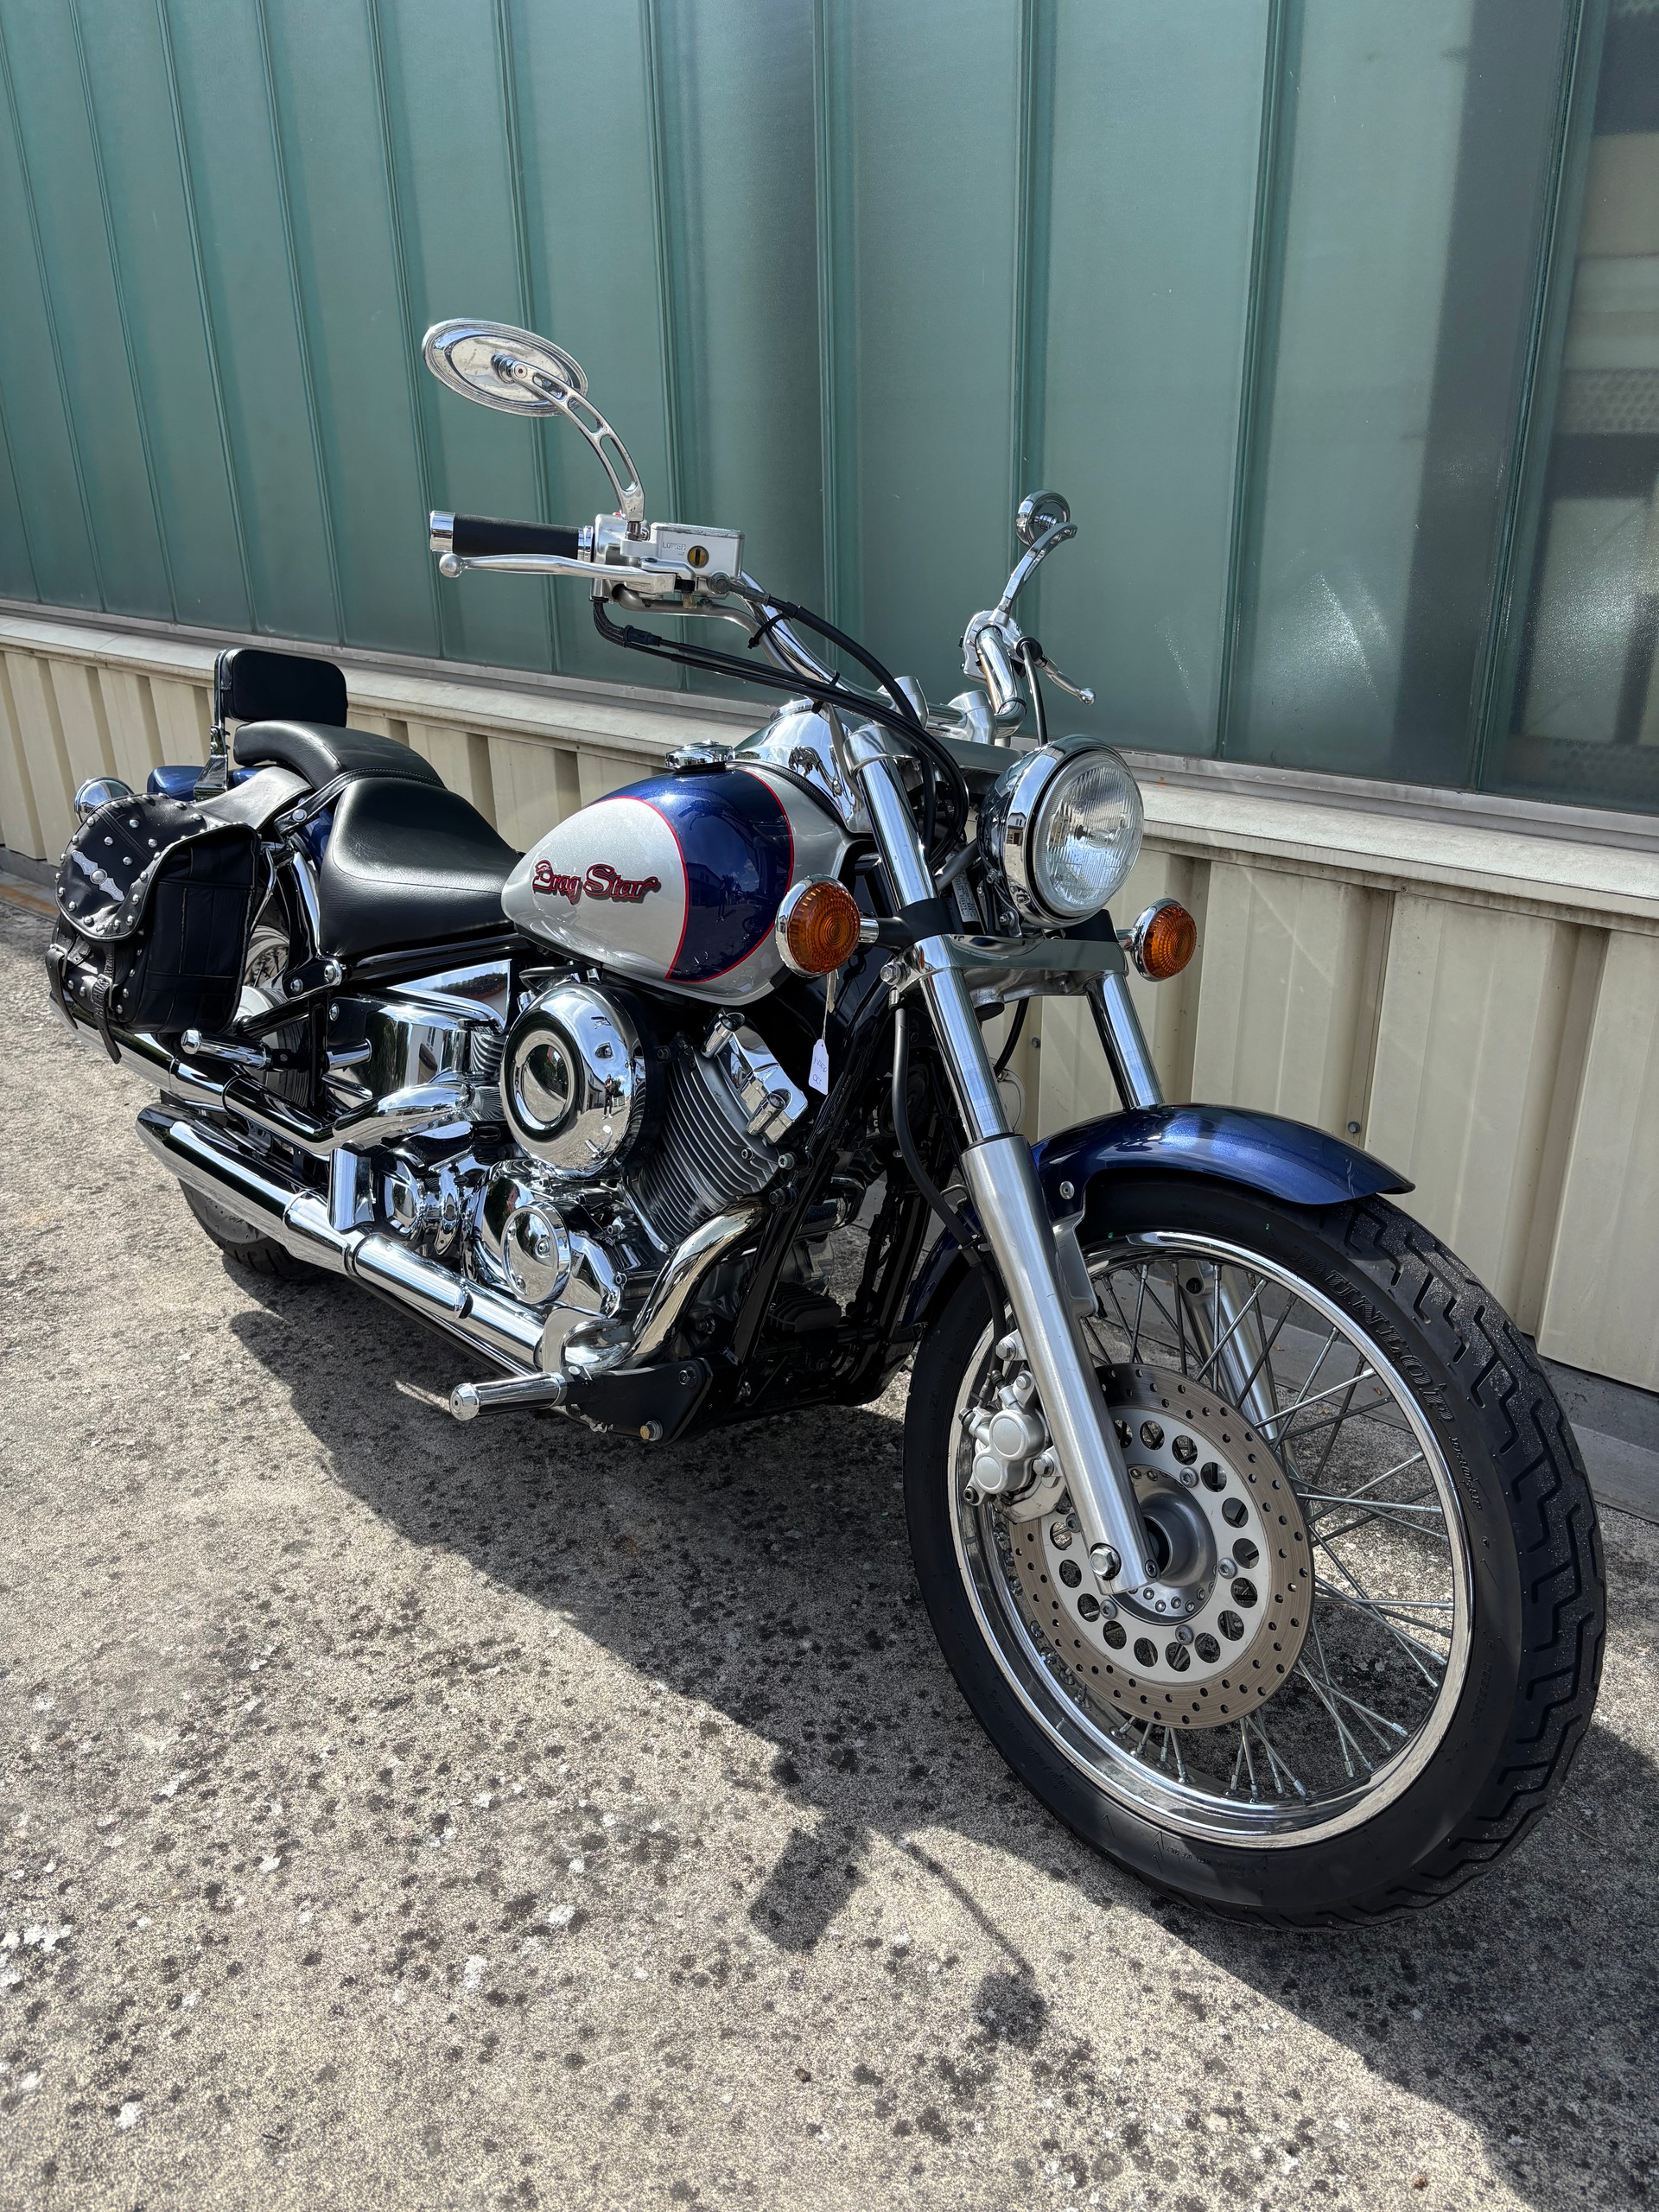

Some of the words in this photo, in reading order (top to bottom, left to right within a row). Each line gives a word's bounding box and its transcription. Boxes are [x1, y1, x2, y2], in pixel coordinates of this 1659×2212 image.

[532, 860, 582, 906] Drag
[582, 862, 662, 904] Star
[1291, 1250, 1456, 1422] DUNLOP
